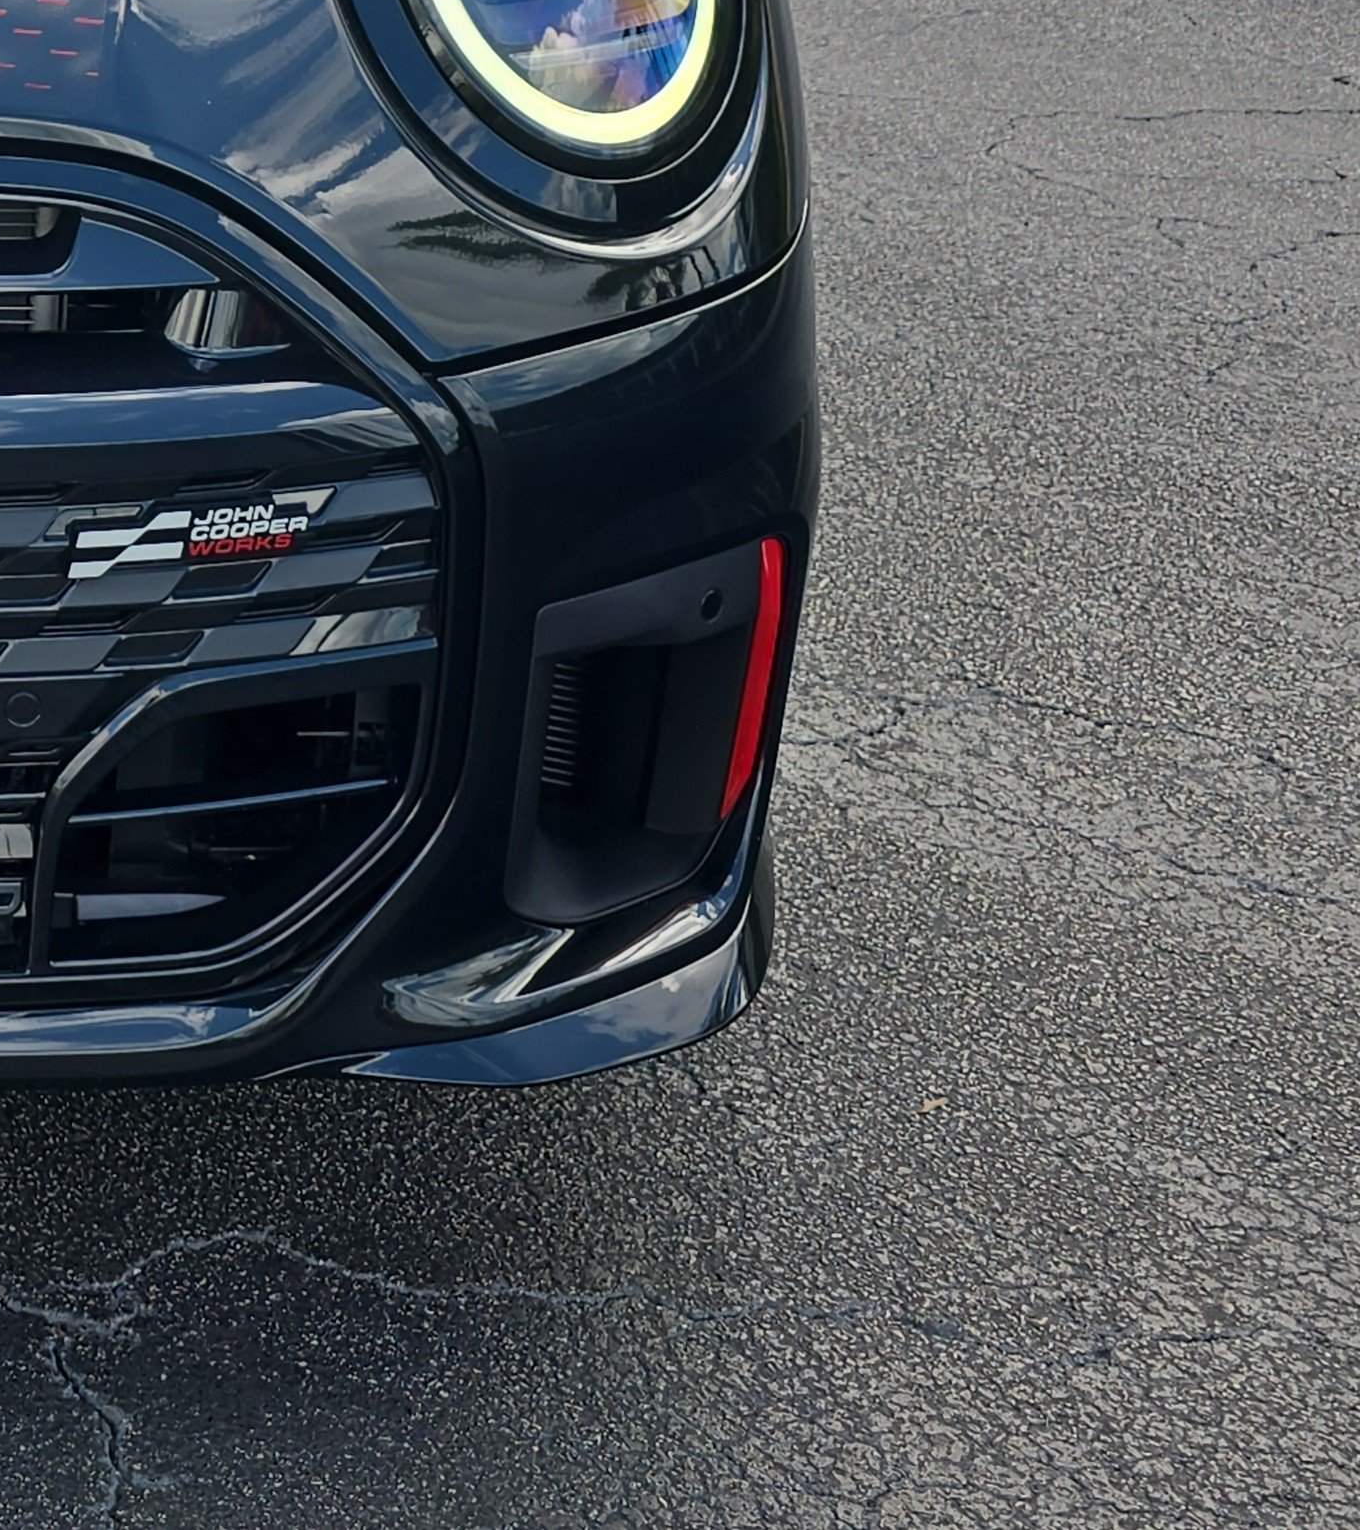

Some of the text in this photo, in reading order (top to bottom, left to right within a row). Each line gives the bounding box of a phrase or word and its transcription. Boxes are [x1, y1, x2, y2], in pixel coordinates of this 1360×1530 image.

[193, 504, 274, 525] JOHN
[190, 516, 309, 541] COOPER
[188, 534, 292, 556] WORKS
